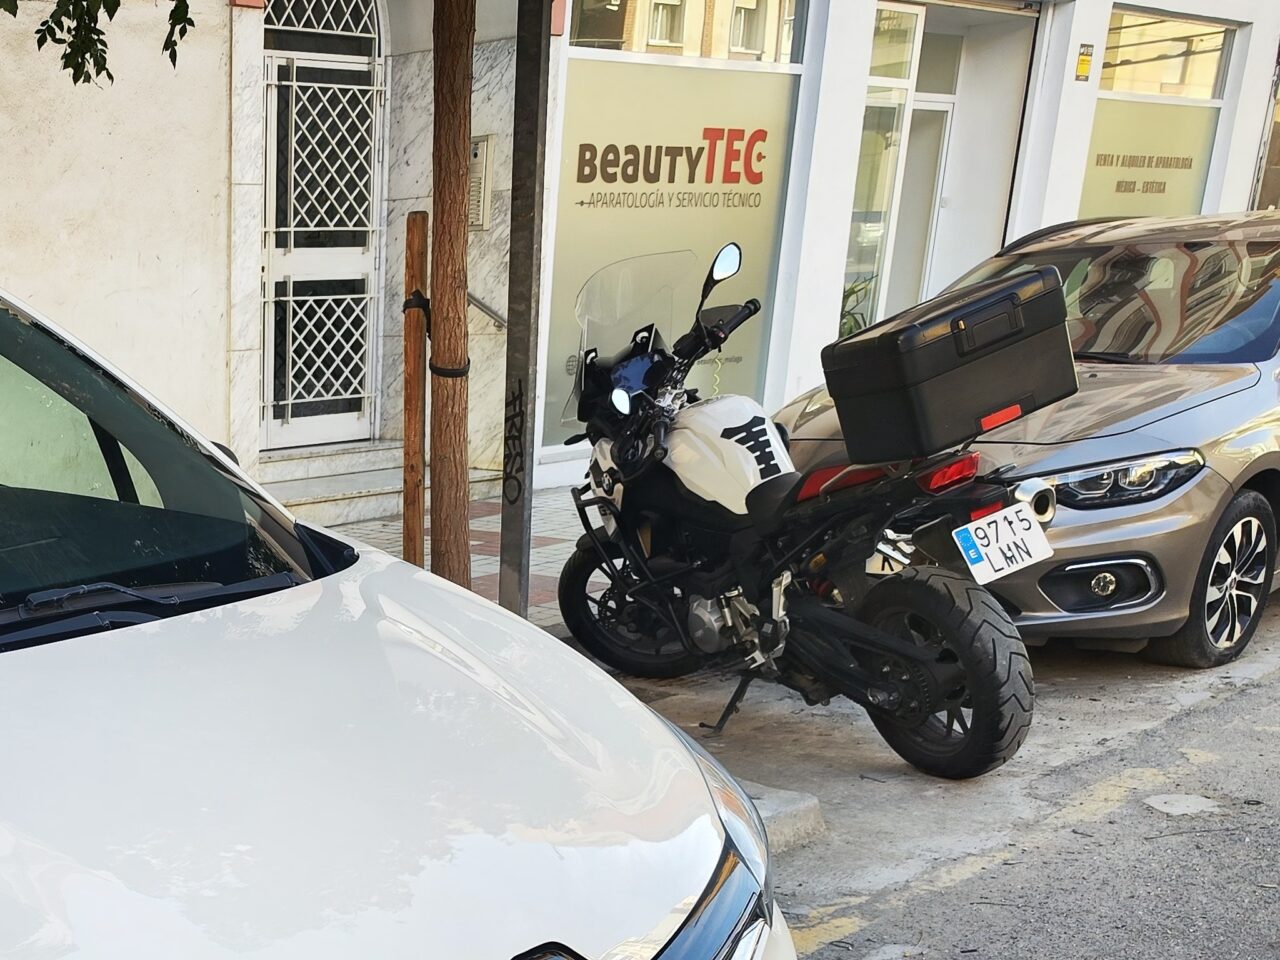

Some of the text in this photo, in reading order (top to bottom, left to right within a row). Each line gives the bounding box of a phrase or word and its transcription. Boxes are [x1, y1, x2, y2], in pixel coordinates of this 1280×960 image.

[1095, 153, 1114, 167] VENTA
[587, 189, 665, 208] APARATOLOGÍA
[675, 191, 721, 208] SERVICIO
[721, 189, 762, 208] TÉCNICO
[974, 508, 1033, 548] 9715
